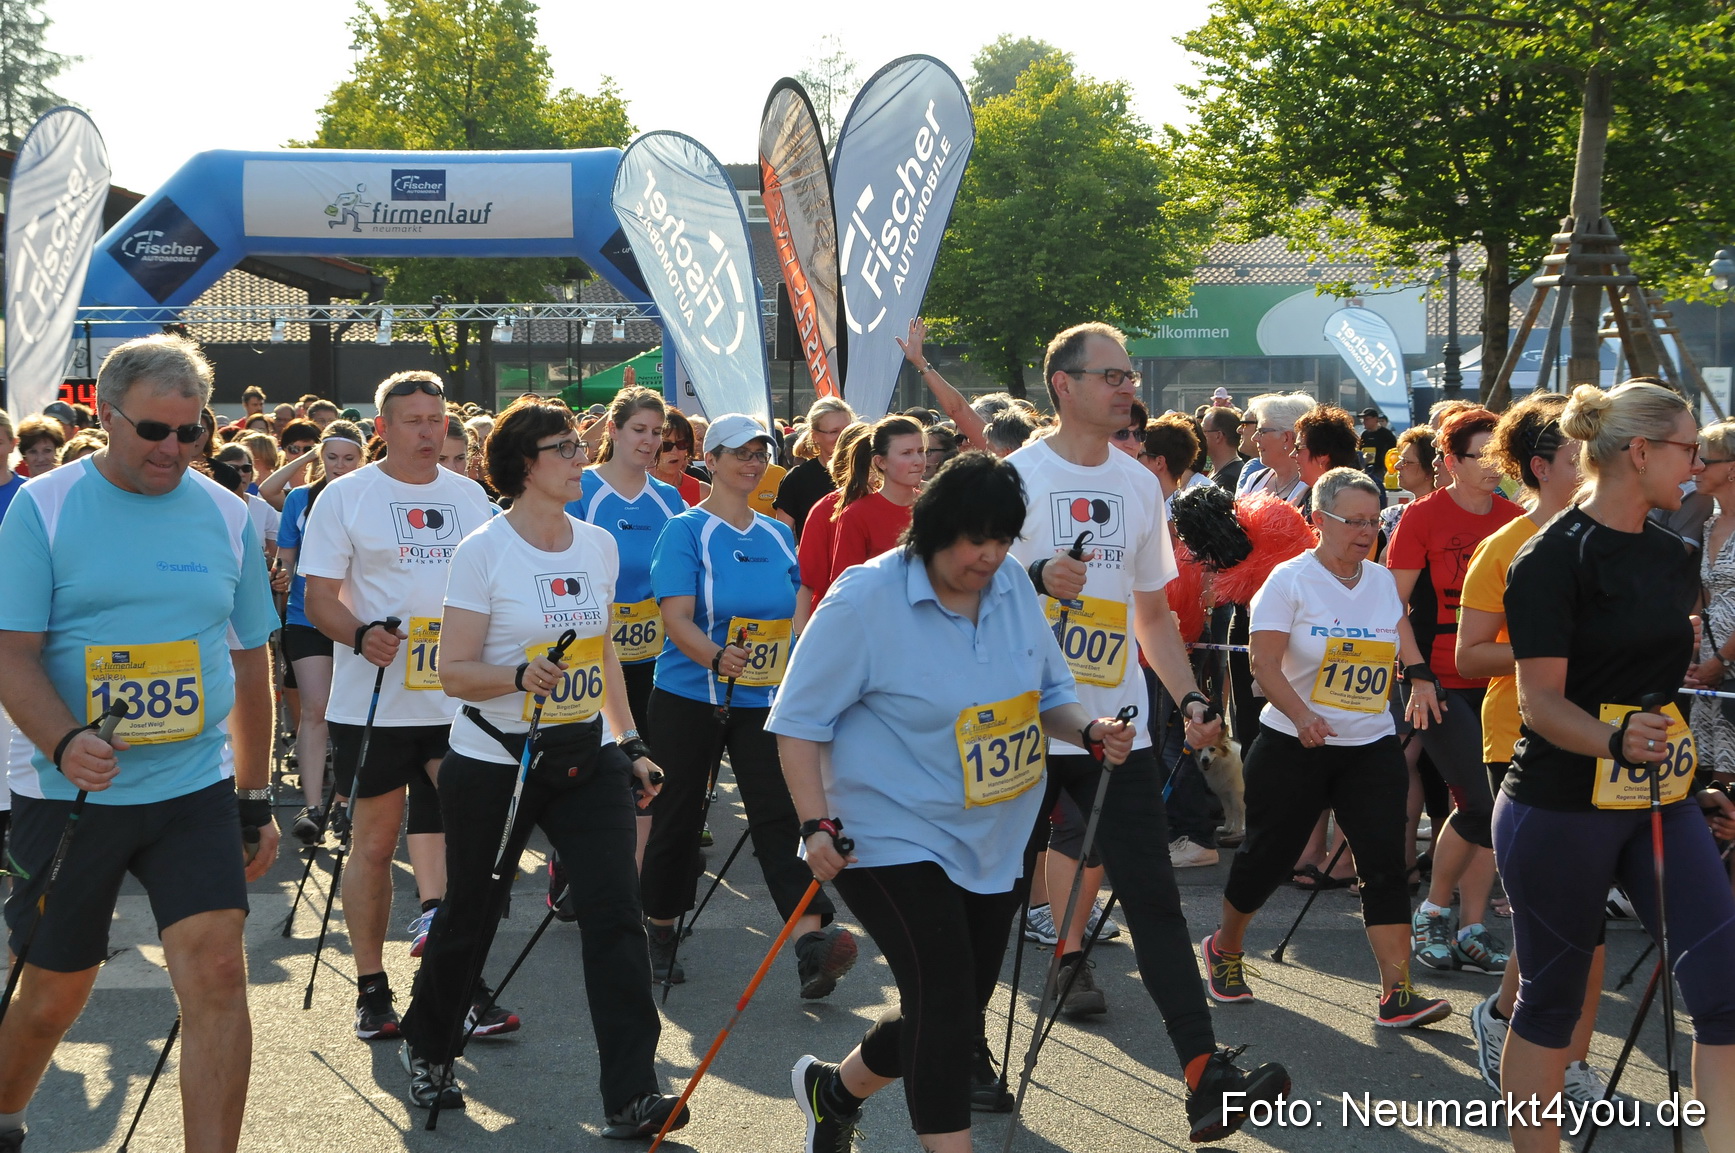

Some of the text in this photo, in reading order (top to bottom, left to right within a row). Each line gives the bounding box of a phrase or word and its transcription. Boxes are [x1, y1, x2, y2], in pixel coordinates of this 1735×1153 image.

[403, 181, 443, 190] Fischer
[860, 99, 943, 300] Fischer
[372, 202, 493, 224] firmenlauf
[893, 135, 952, 296] AUTOMOBILE
[29, 145, 89, 313] Fischer
[372, 225, 423, 233] neumarkt
[135, 241, 203, 256] Fischer
[399, 546, 455, 558] POLGE
[170, 561, 209, 573] sumida
[544, 610, 602, 624] POLGER
[544, 620, 602, 628] TRANSPORT
[613, 620, 657, 646] 486
[104, 661, 146, 670] firmenlauf
[1323, 663, 1388, 695] 1190
[92, 676, 200, 720] 1385
[966, 724, 1042, 783] 1372
